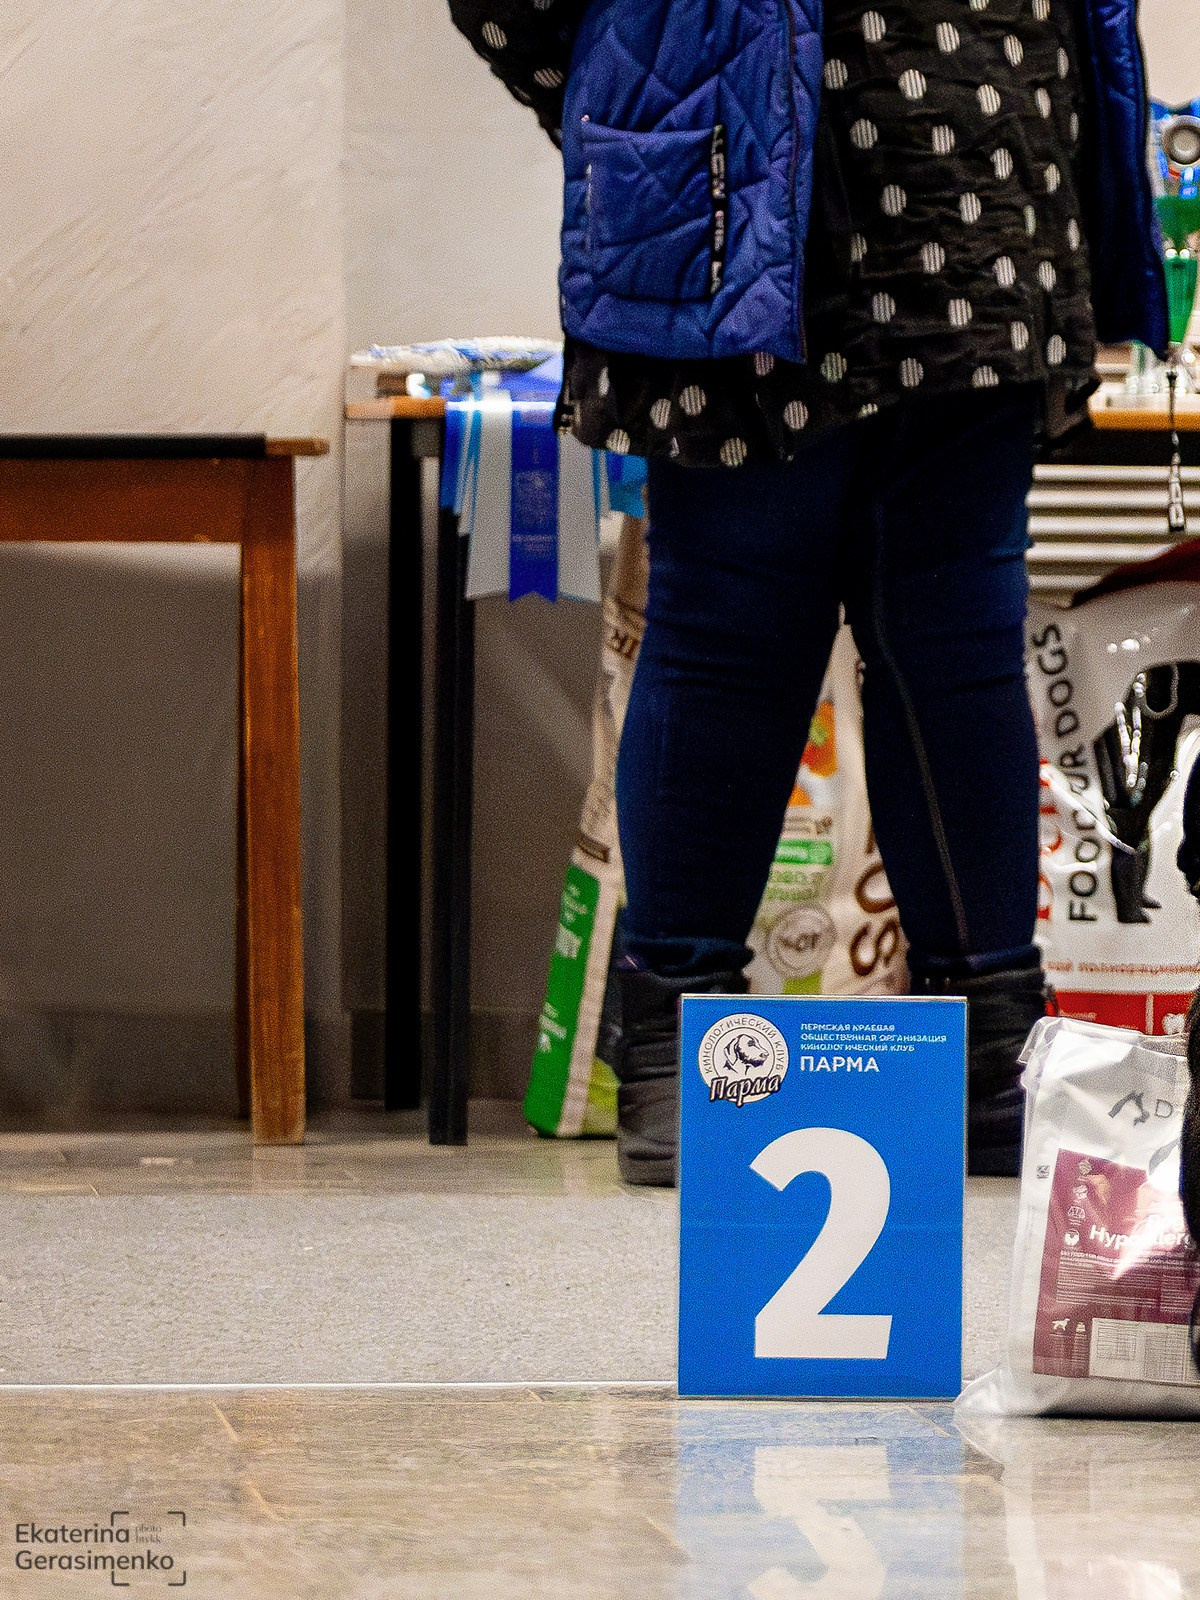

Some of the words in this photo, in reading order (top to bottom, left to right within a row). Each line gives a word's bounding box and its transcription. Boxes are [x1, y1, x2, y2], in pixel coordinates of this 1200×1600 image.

[1032, 624, 1079, 739] DOGS
[801, 1023, 850, 1032] ПЕРМСКАЯ
[801, 1033, 877, 1042] ОБЩЕСТВЕННАЯ
[879, 1034, 947, 1043] ОРГАНИЗАЦИЯ
[703, 1018, 777, 1074] КИНОЛОГИЧЕСКИЙ
[774, 1039, 785, 1071] КЛУБ
[801, 1042, 888, 1051] КИНОЛОГИЧЕСКИЙ
[890, 1044, 915, 1052] КЛУБ
[800, 1056, 880, 1073] ПАРМА
[711, 1075, 782, 1107] Парма
[749, 1126, 893, 1360] 2
